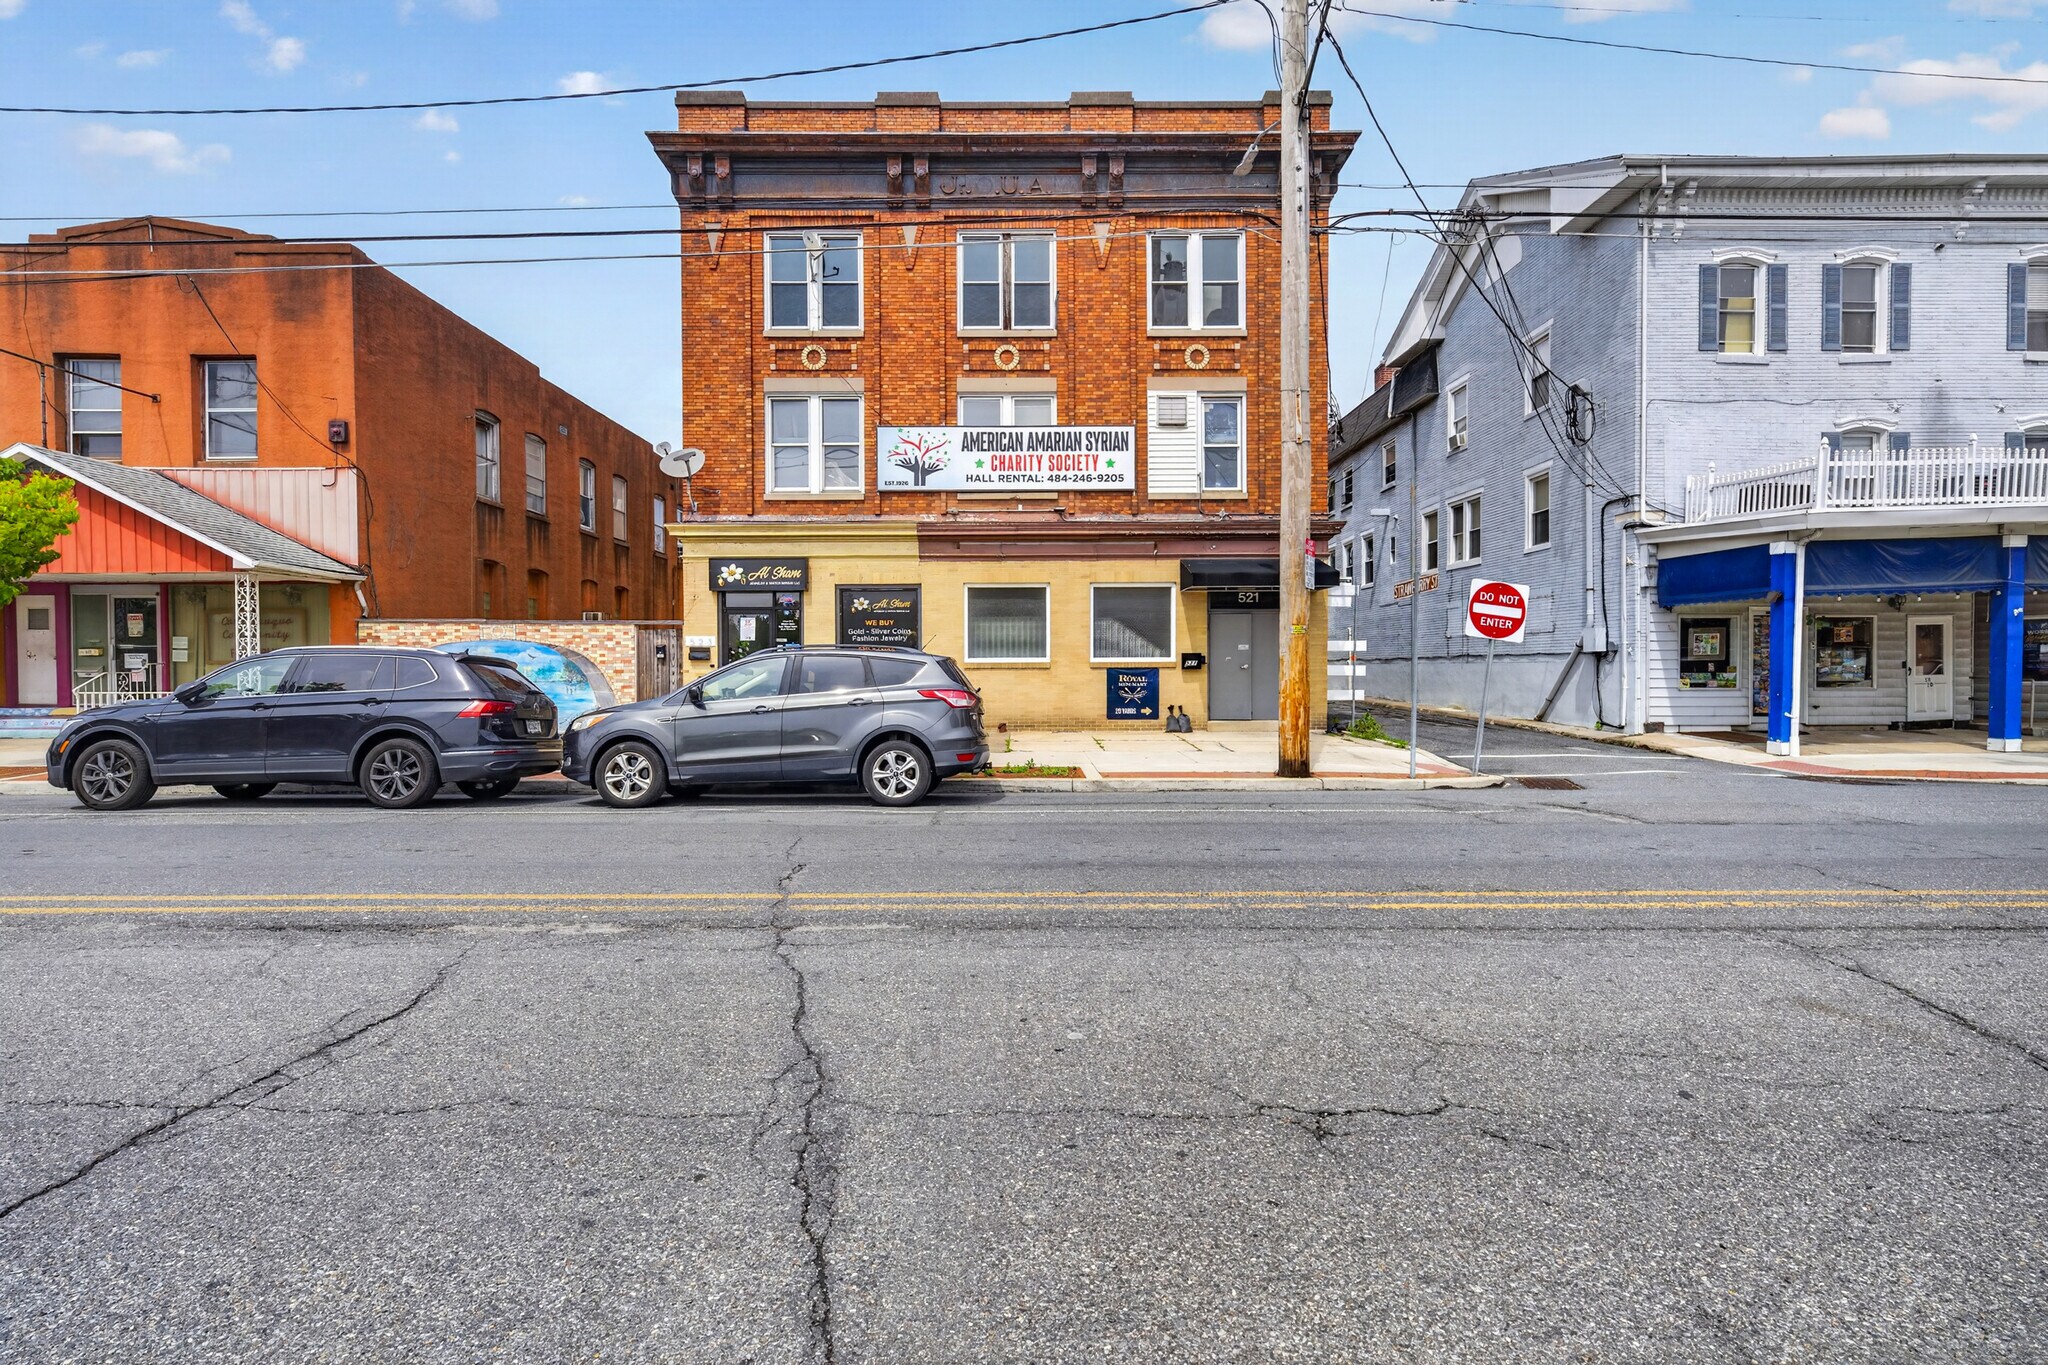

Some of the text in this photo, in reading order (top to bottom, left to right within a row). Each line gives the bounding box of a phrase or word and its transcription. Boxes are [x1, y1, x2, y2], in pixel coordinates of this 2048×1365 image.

[961, 431, 1129, 452] AMERICAN AMARIAN SYRIAN
[991, 454, 1099, 472] CHARITY SOCIETY
[966, 474, 1125, 483] HALL RENTAL: 484-246-9205
[748, 566, 802, 581] Al Sham
[890, 598, 912, 609] Sham
[1238, 592, 1259, 603] 521
[1479, 592, 1520, 606] DO NOT
[1480, 616, 1513, 629] ENTER
[880, 635, 908, 643] Jewelry
